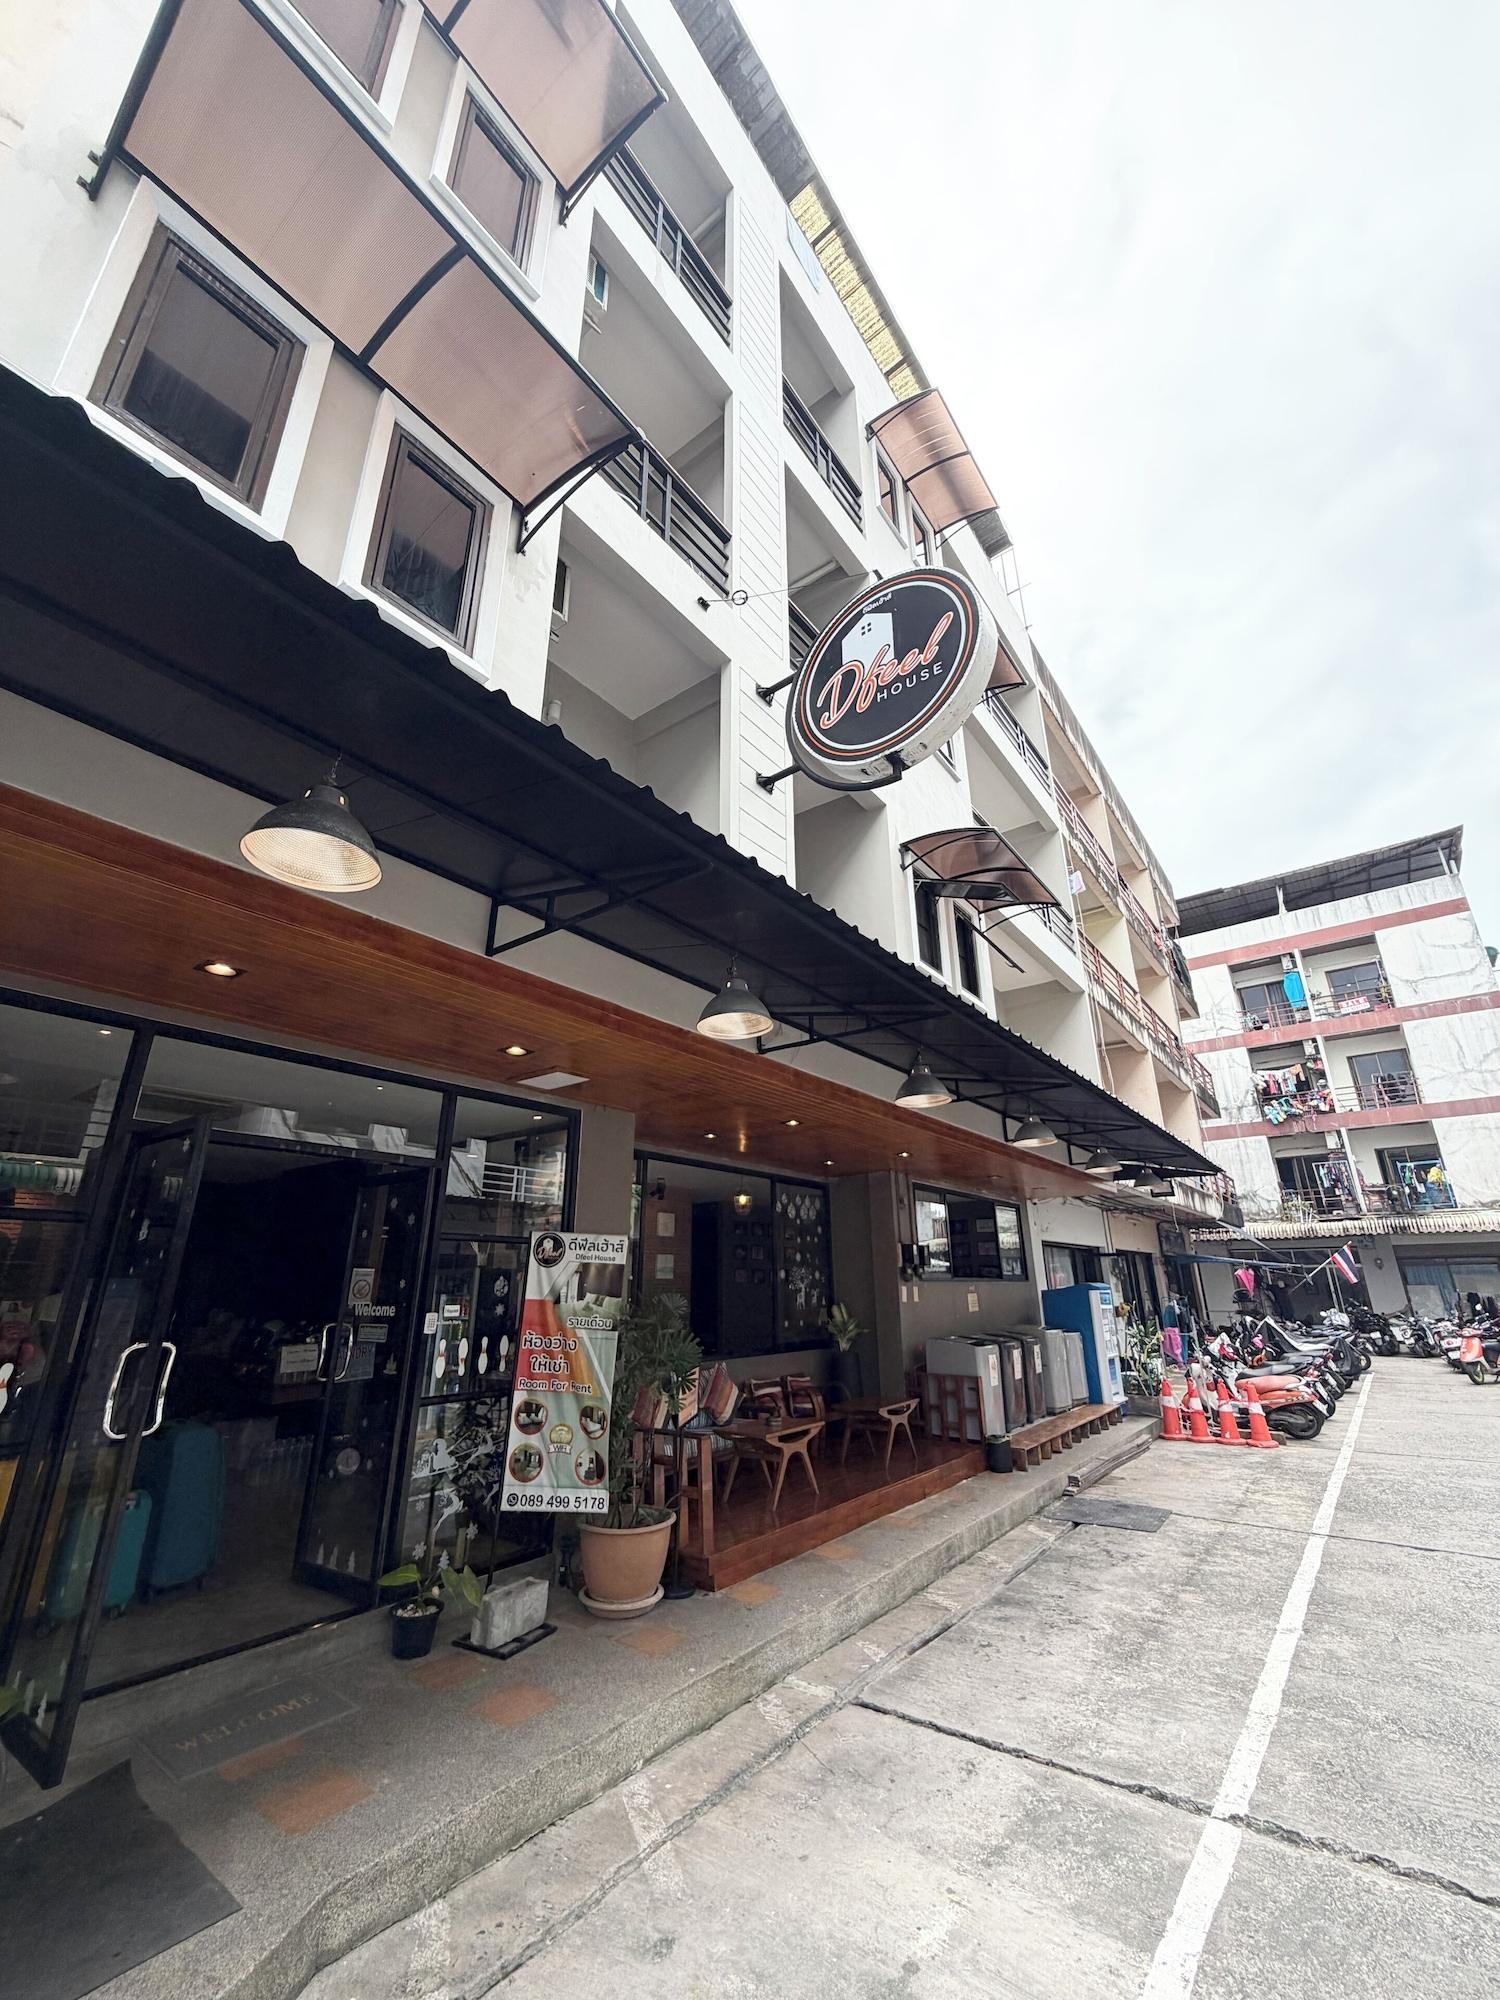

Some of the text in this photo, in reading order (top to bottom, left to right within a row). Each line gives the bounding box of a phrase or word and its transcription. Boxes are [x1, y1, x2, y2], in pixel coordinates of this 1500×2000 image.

[817, 611, 954, 730] Dfeel
[877, 662, 943, 703] HOUSE
[568, 1238, 625, 1254] ดีฟีลเฮ้าส์
[575, 1253, 616, 1262] Dfeel House
[355, 1303, 396, 1317] Welcome
[567, 1315, 612, 1329] รายเดือน
[523, 1331, 577, 1351] ห้องว่าง
[531, 1355, 569, 1373] ให้เช่า
[519, 1379, 592, 1393] Room For Rent
[520, 1494, 605, 1510] 089 499 5178
